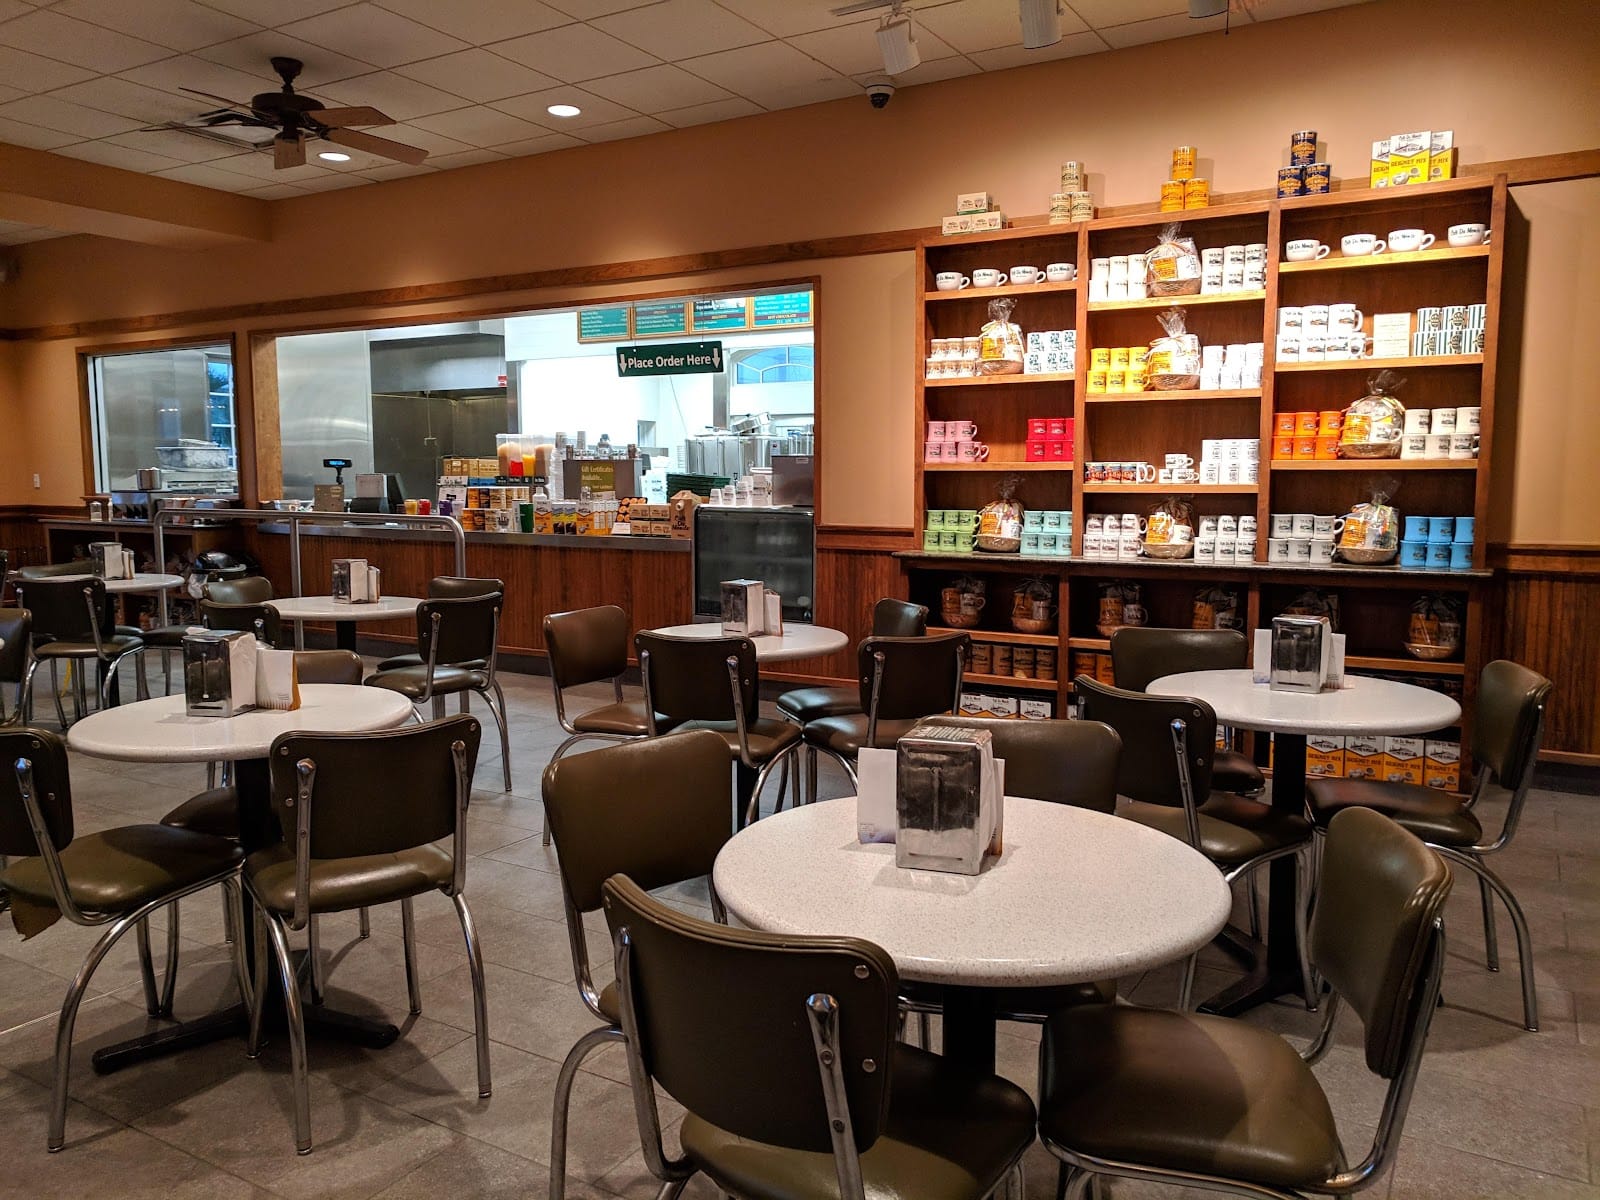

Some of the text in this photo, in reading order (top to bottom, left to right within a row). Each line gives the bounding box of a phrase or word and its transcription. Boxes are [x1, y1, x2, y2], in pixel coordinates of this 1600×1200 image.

[628, 354, 711, 369] Place Order Here
